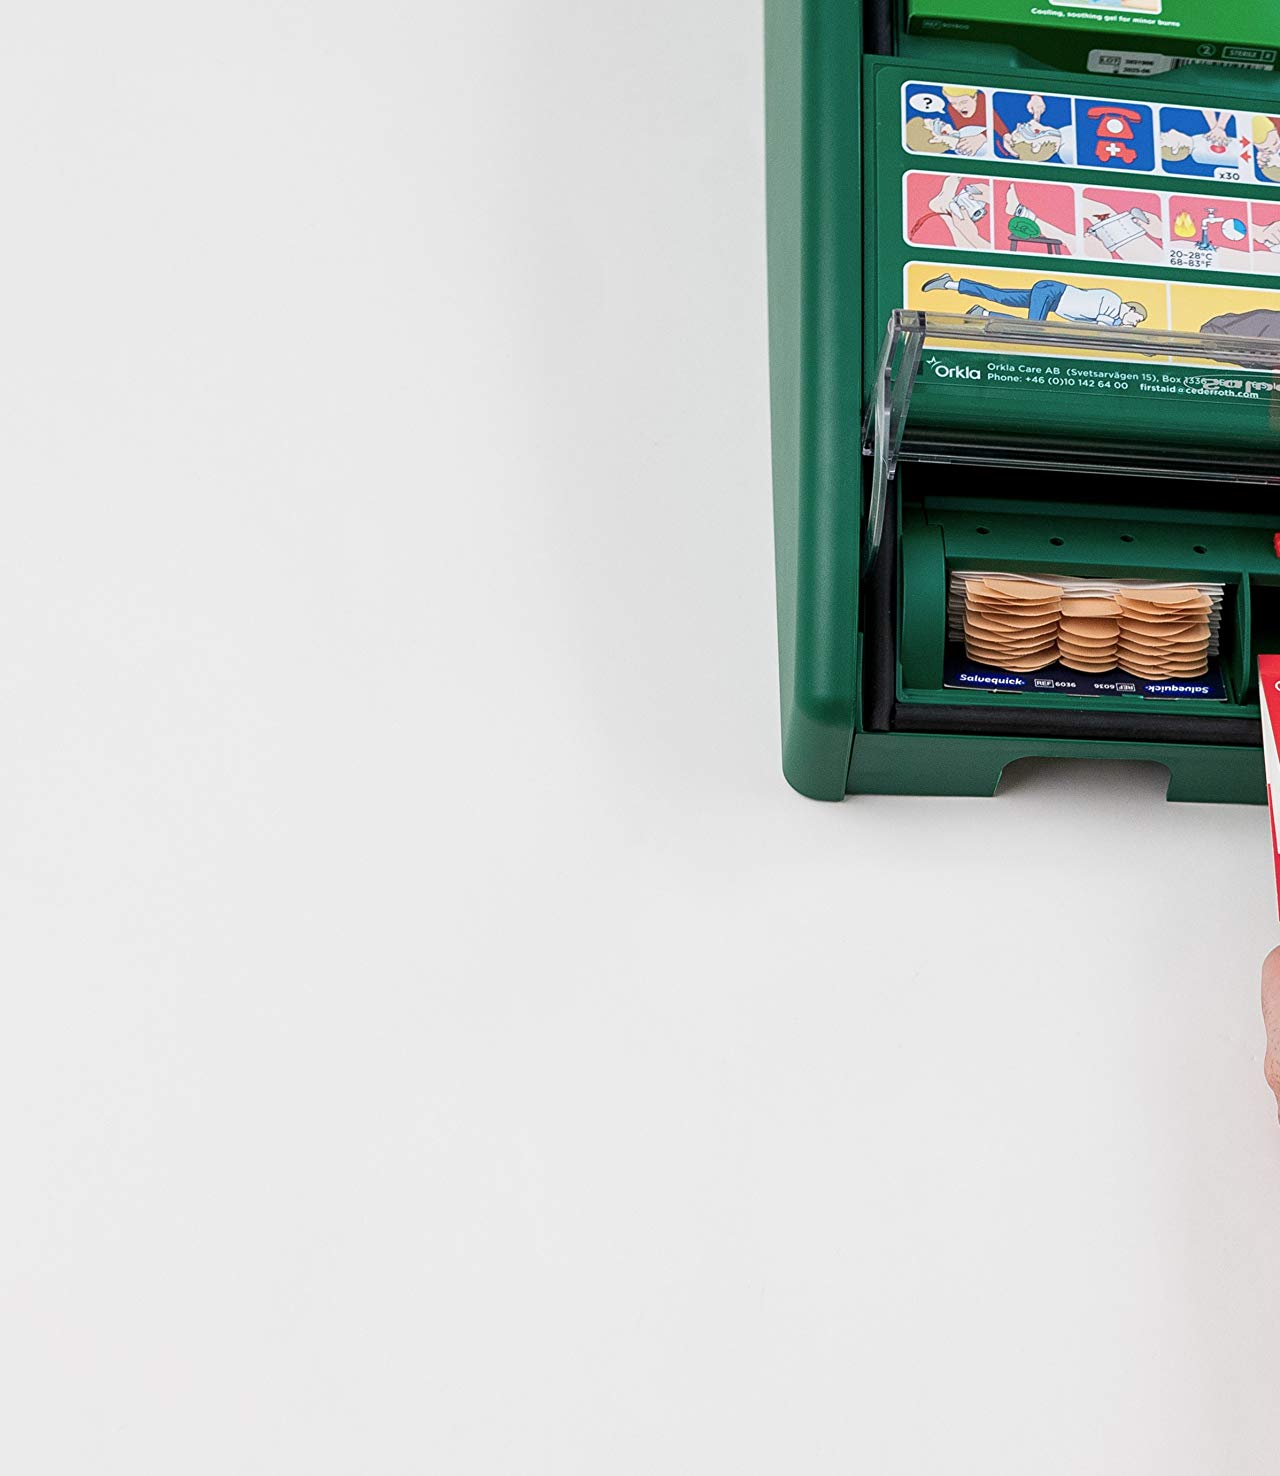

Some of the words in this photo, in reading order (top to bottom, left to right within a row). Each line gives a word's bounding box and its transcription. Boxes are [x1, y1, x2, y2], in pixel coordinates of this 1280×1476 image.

[1031, 7, 1065, 18] Cooling,
[1066, 11, 1102, 22] soothing
[1132, 17, 1156, 25] minor
[1157, 19, 1181, 27] burns
[1220, 172, 1240, 181] x30
[935, 364, 981, 380] Orkla
[987, 362, 1016, 373] Orkla
[1018, 364, 1042, 374] Care
[1045, 366, 1061, 375] AB
[1162, 375, 1182, 384] Box
[987, 373, 1022, 383] Phone:
[1025, 376, 1045, 384] +46
[1048, 377, 1075, 387] (0)10
[1078, 379, 1095, 388] 142
[1097, 380, 1111, 389] 64
[1114, 382, 1129, 390] 00
[960, 674, 1022, 685] Salvequick
[1148, 685, 1209, 694] Salvequick
